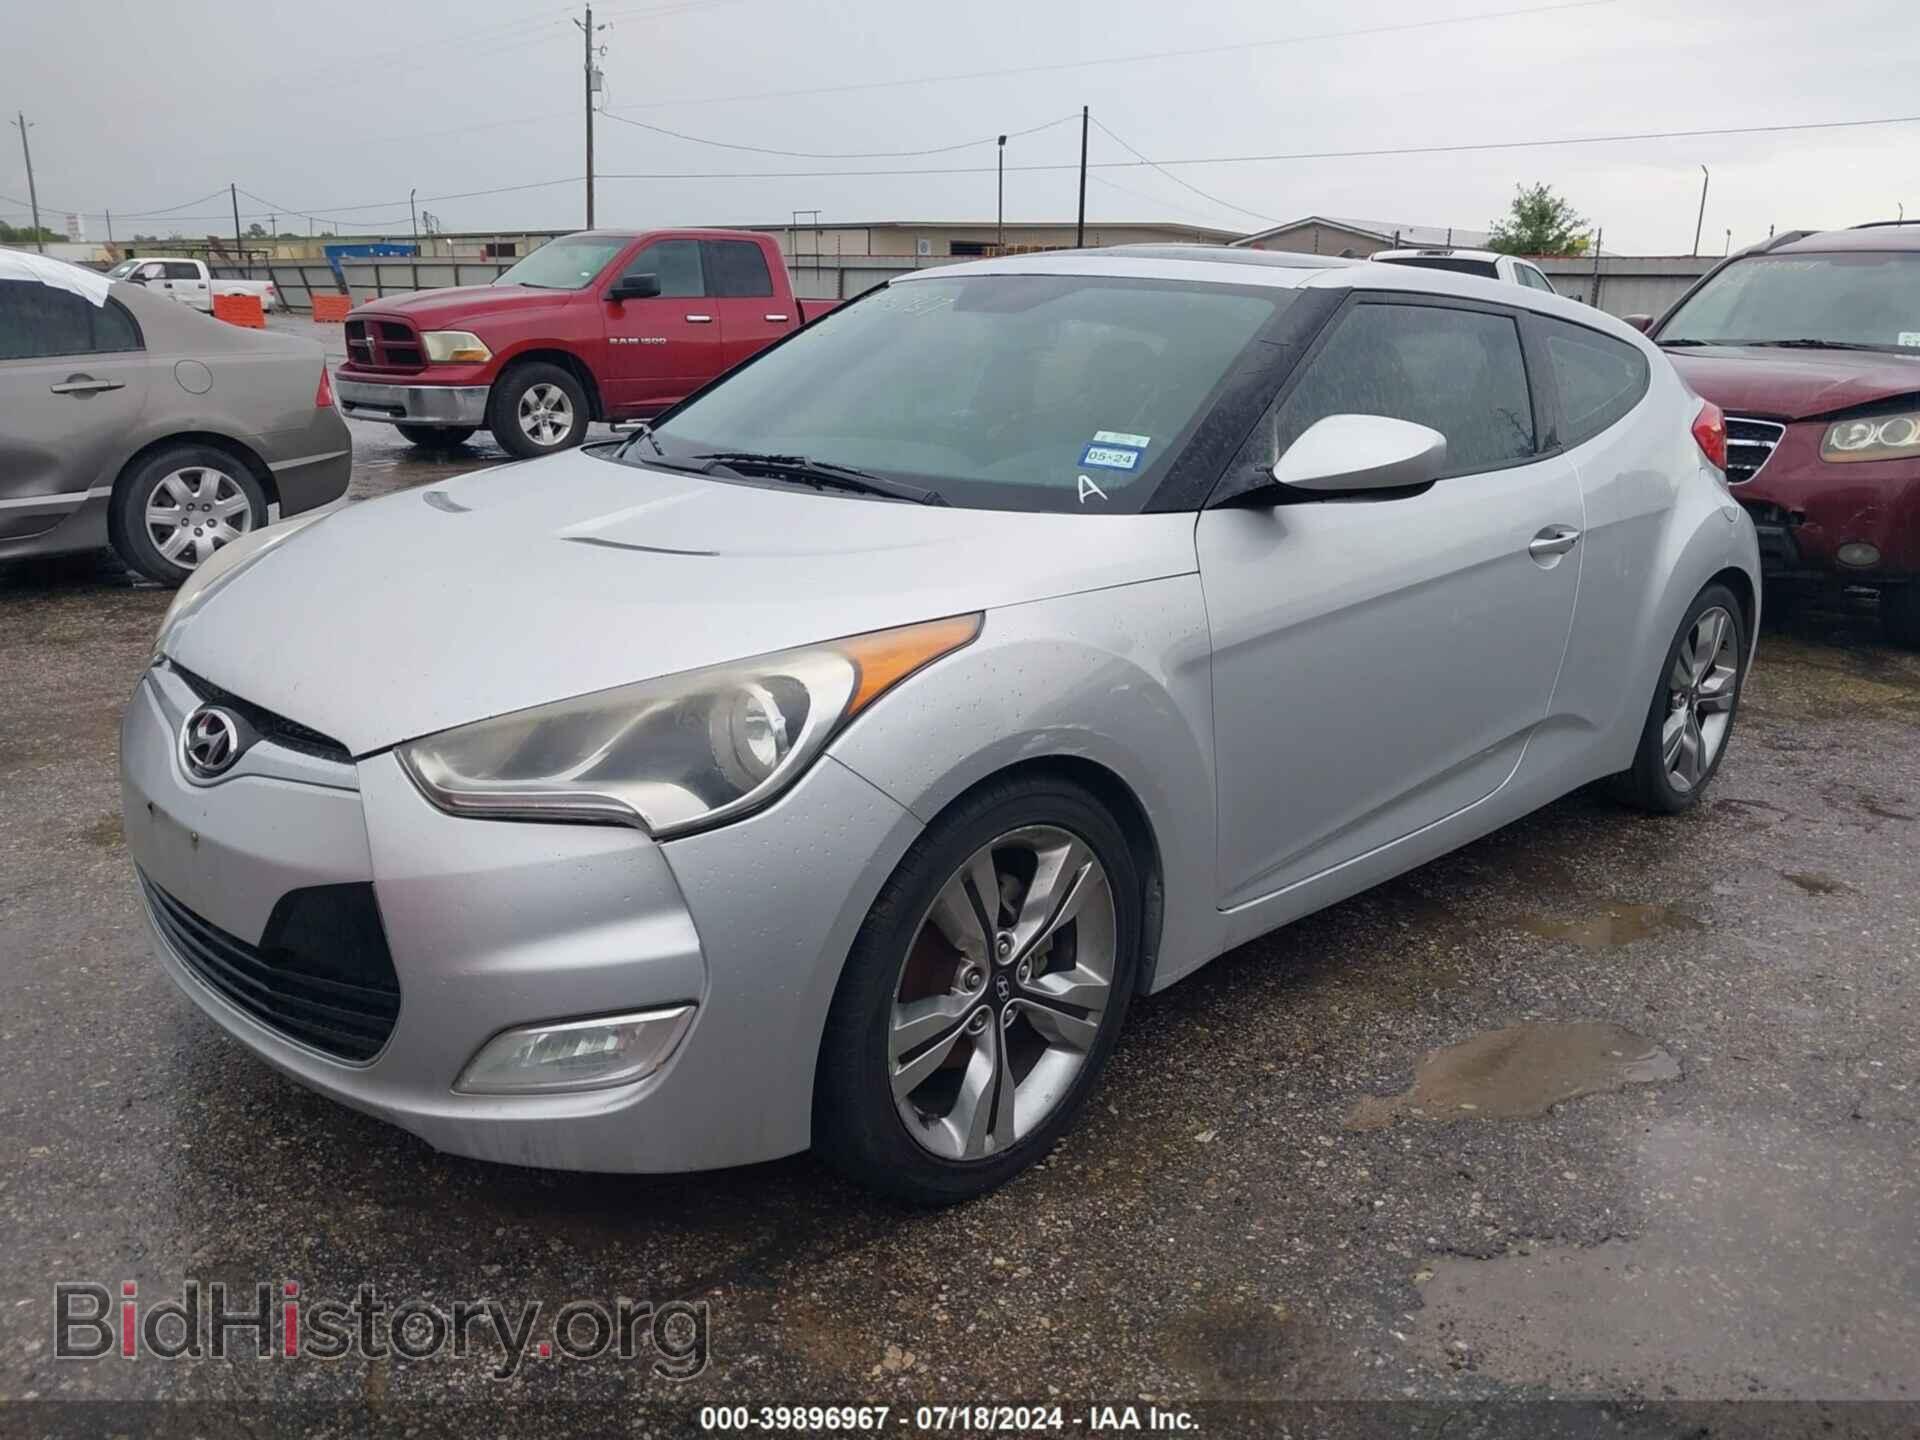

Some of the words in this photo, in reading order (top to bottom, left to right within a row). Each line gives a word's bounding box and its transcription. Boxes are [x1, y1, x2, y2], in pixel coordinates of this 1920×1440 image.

[608, 337, 639, 345] RAM
[641, 337, 667, 345] 1500
[1077, 474, 1109, 504] A
